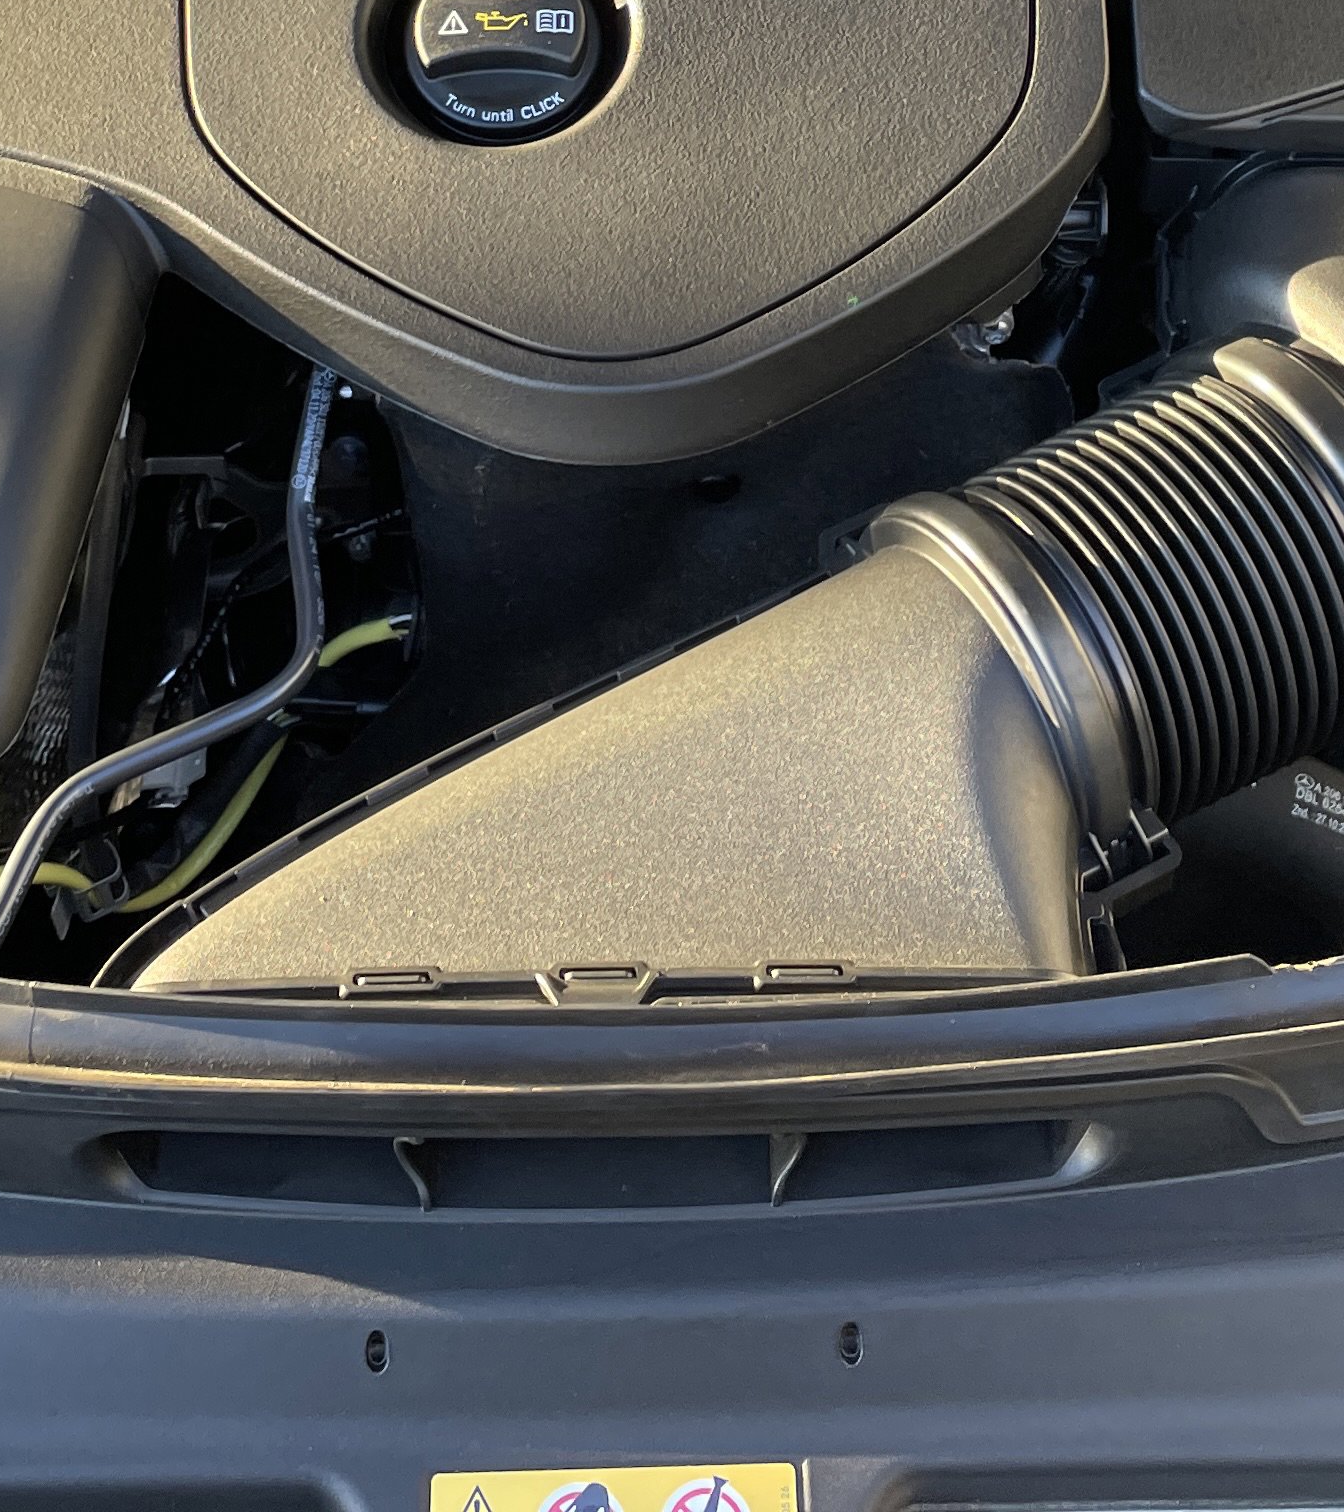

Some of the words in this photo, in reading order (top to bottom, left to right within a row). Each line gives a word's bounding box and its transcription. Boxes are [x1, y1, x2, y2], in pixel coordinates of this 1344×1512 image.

[445, 93, 475, 118] Turn
[481, 108, 514, 122] until
[521, 92, 565, 120] CLICK
